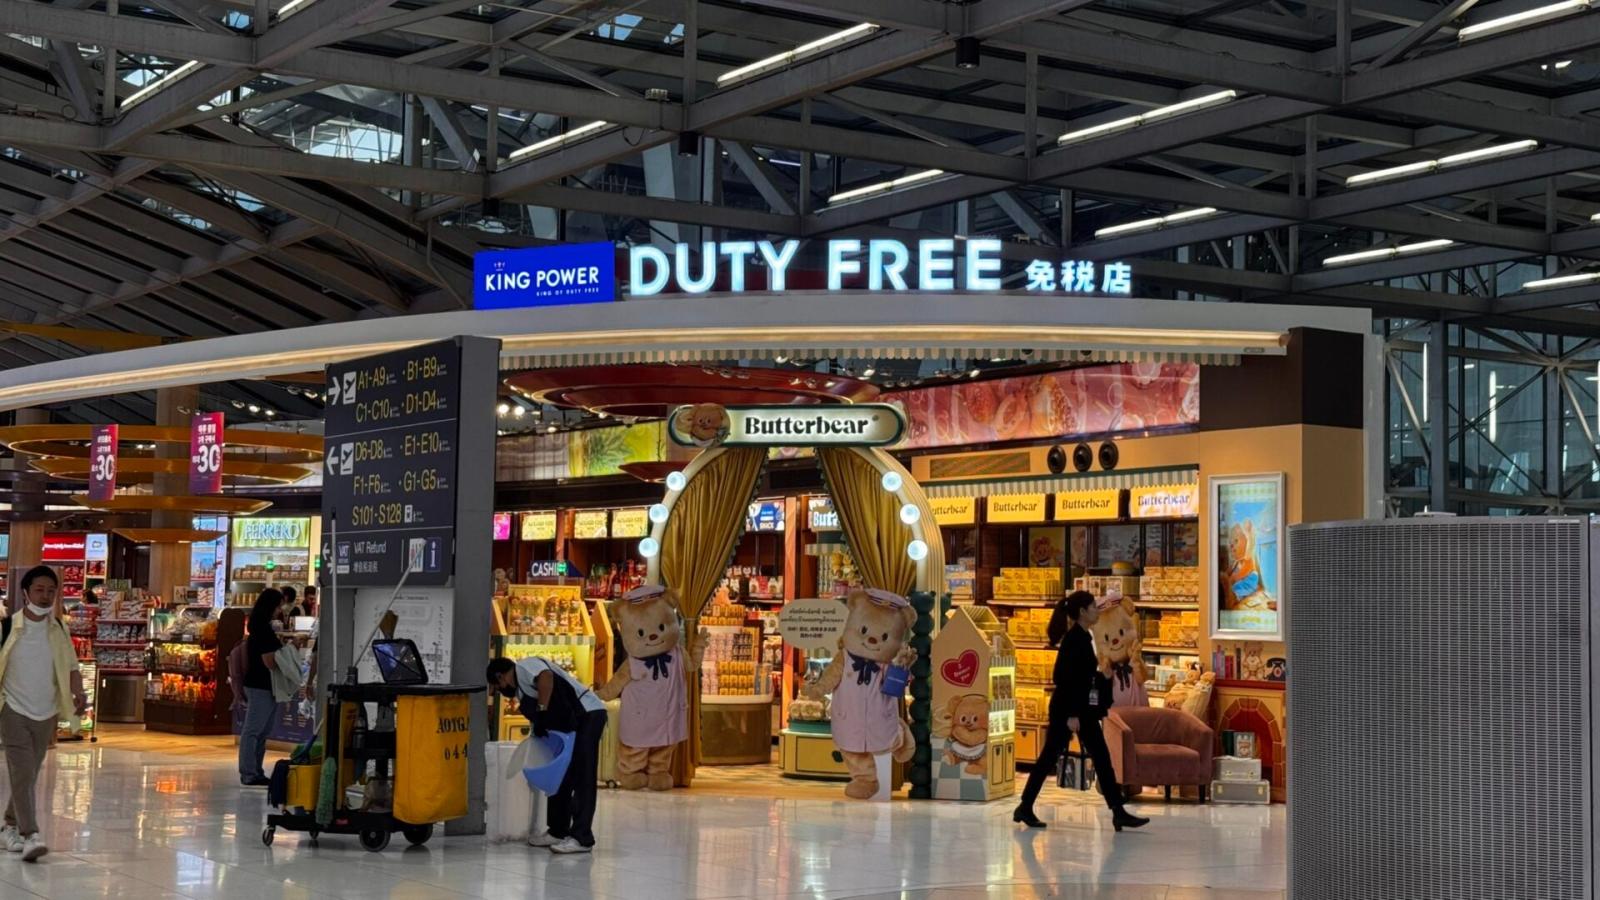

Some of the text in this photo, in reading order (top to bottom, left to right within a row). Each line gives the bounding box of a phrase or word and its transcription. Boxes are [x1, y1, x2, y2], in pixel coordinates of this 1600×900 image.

[629, 238, 1002, 296] DUTY FREE
[1024, 258, 1133, 294] 免税店
[485, 266, 599, 291] KING POWER
[358, 366, 386, 390] A1-A9
[407, 356, 437, 381] B1-B9
[356, 398, 390, 423] C1-C10
[406, 389, 437, 414] D1-D4
[745, 416, 869, 435] Butterbear
[355, 439, 384, 461] D6-D8
[405, 432, 439, 456] E1-E10
[353, 474, 381, 496] F1-F6
[403, 469, 436, 492] G1-G5
[993, 500, 1038, 513] Butterbear
[1062, 498, 1111, 511] Butterbear
[1138, 494, 1190, 507] Butterbear
[244, 523, 300, 540] FERRERO
[338, 544, 350, 557] VAT
[353, 540, 387, 554] VAT Refund
